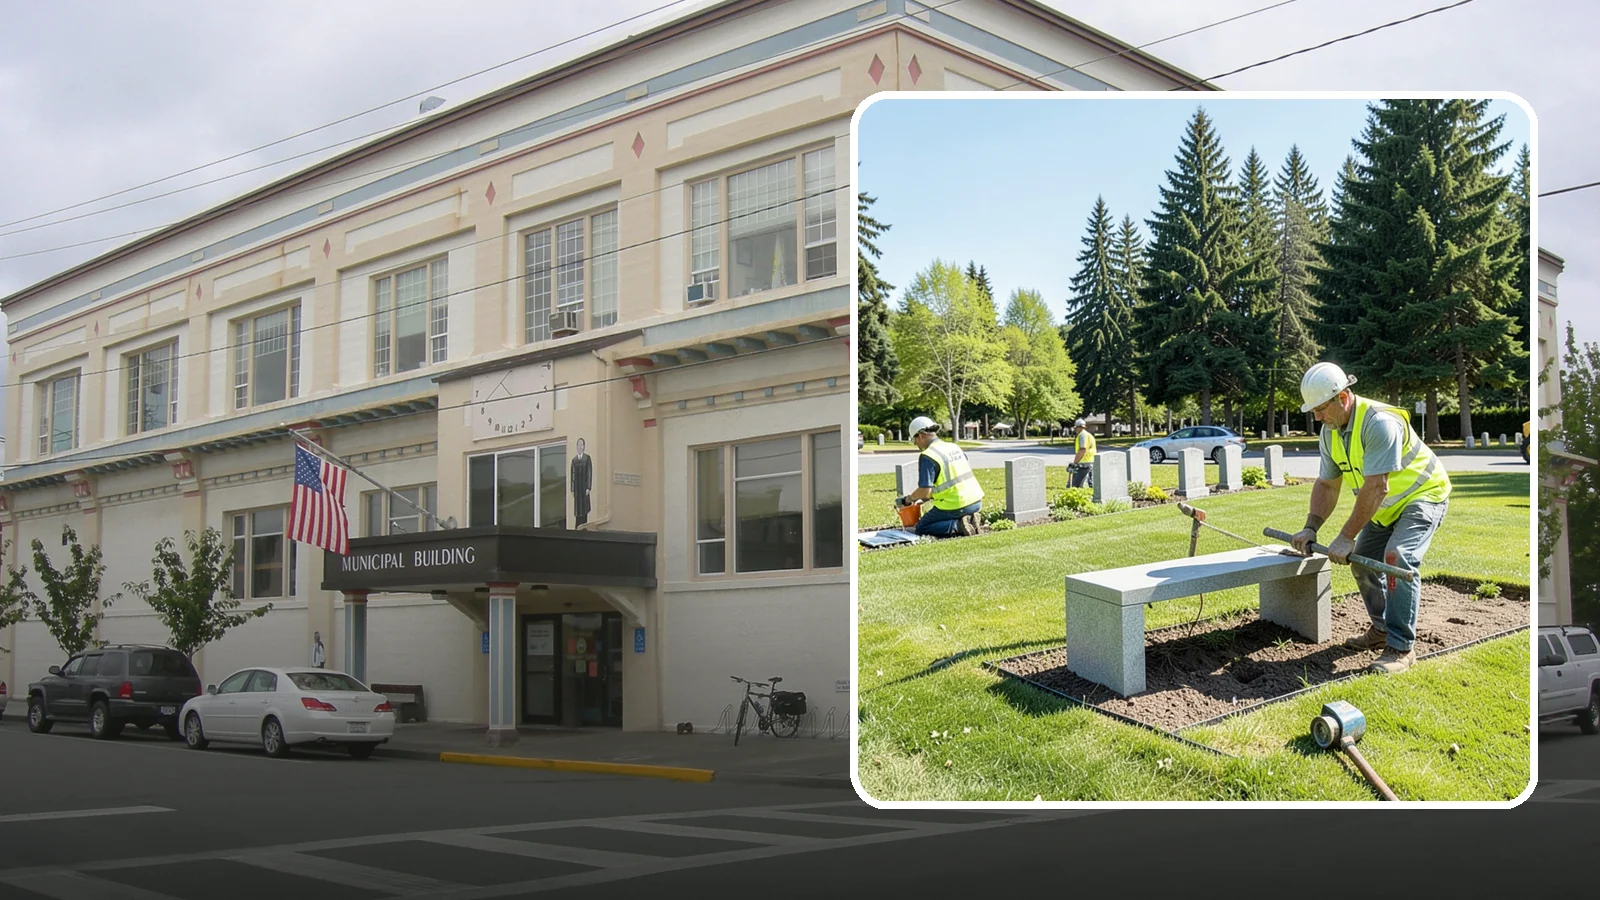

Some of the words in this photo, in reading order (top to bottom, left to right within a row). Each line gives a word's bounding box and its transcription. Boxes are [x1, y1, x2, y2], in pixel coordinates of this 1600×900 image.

[475, 390, 479, 398] 7
[480, 407, 485, 415] 8
[487, 417, 493, 426] 9
[494, 423, 500, 431] 10
[507, 425, 513, 433] 12
[521, 420, 526, 428] 2
[529, 413, 533, 422] 3
[536, 402, 540, 410] 4
[342, 552, 405, 572] MUNICIPAL
[414, 546, 475, 567] BUILDING
